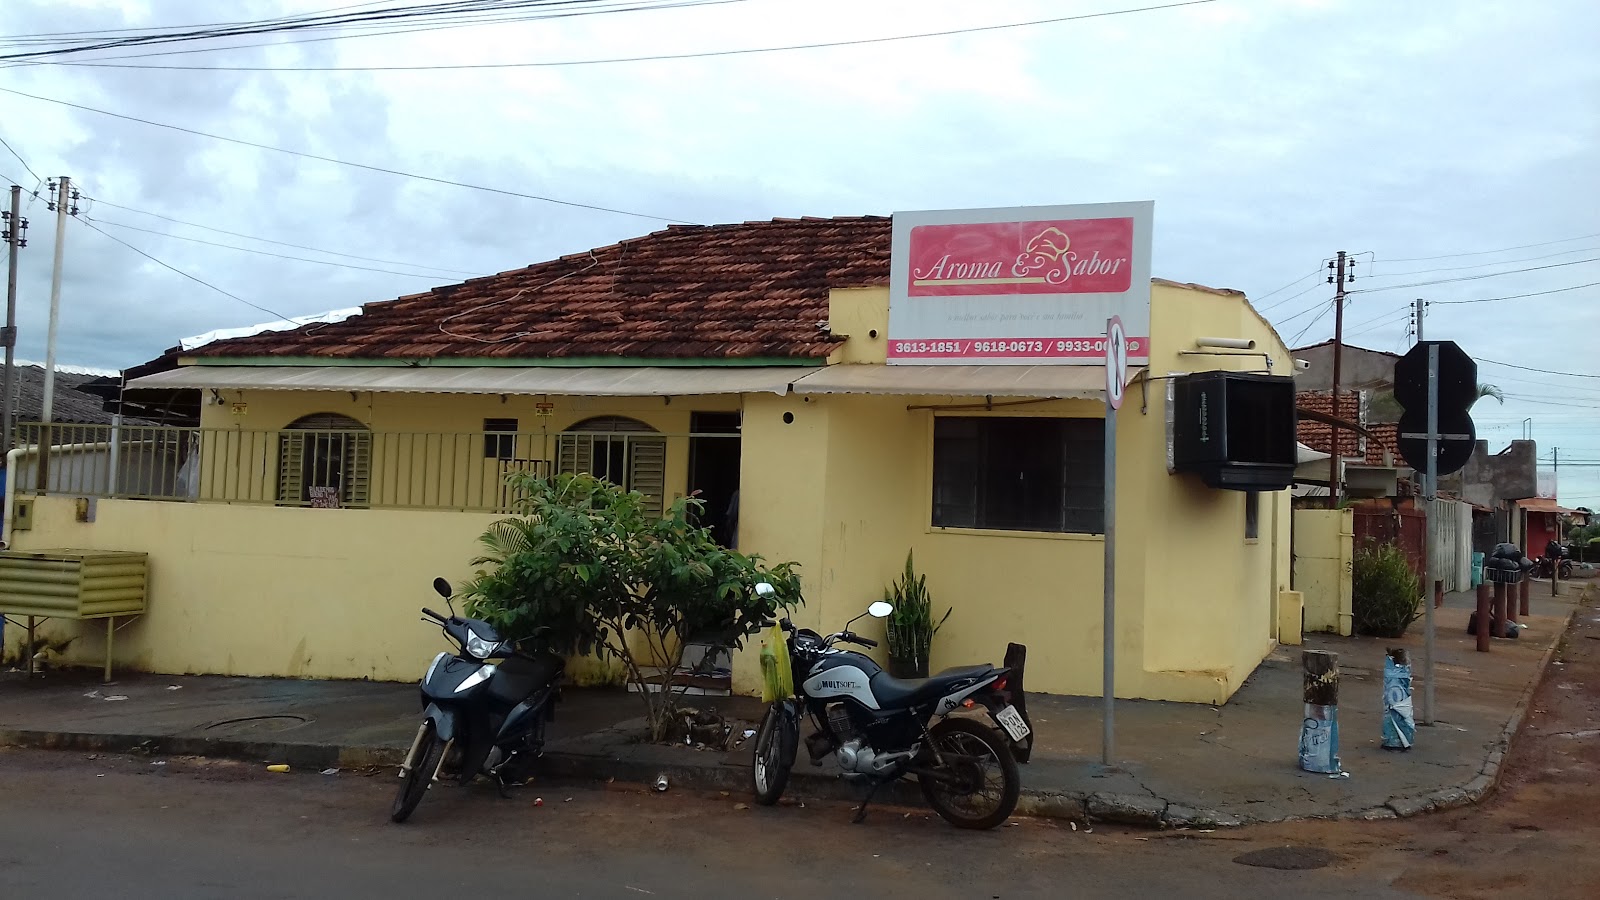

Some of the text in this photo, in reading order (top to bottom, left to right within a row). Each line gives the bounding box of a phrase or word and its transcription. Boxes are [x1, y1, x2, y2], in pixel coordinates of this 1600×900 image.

[913, 250, 1127, 285] Aroma & Sabor
[1000, 314, 1018, 322] para
[895, 342, 961, 352] 3613-1851
[974, 341, 1042, 352] 9618-0673
[1056, 340, 1128, 352] 9933-0
[822, 680, 856, 688] MULTSOFT
[1012, 722, 1028, 738] 1125
